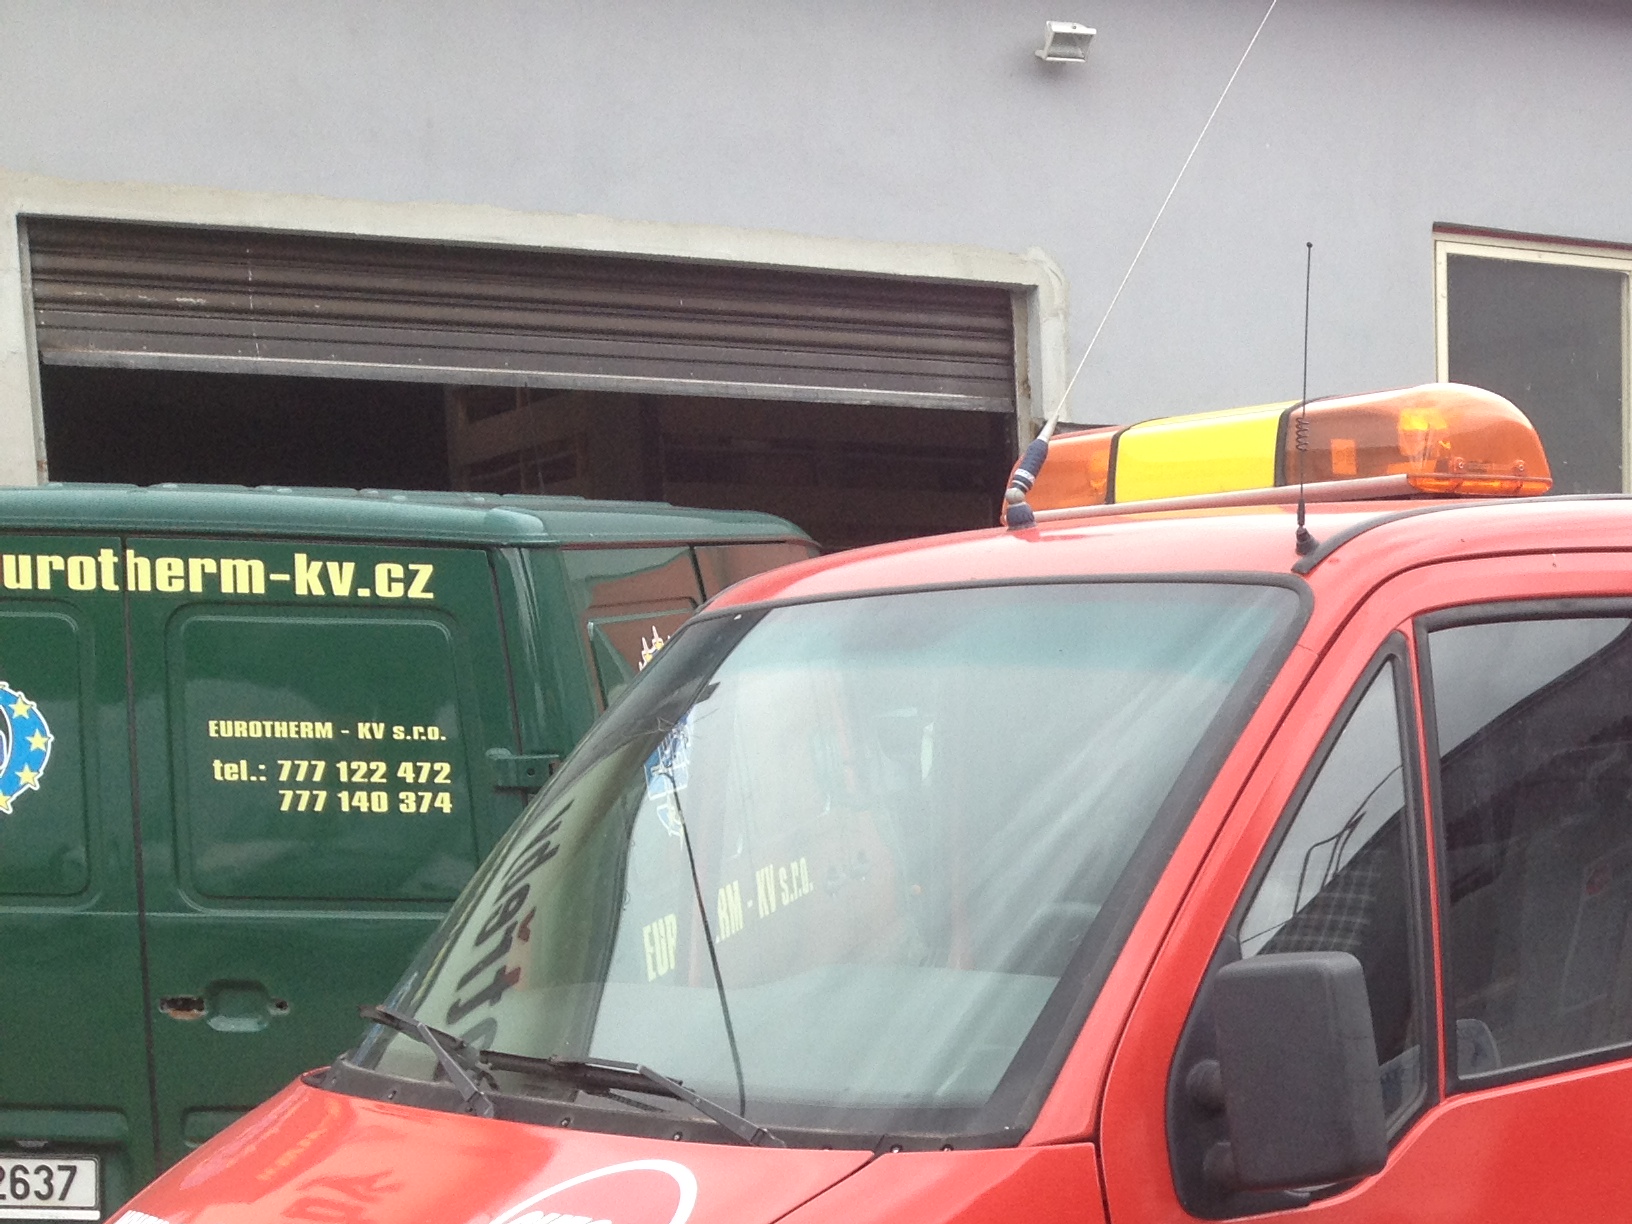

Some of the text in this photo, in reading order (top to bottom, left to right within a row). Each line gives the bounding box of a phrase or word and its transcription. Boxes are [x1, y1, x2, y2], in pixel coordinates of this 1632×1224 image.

[208, 720, 333, 739] EUROTHERM
[357, 722, 385, 740] KV
[392, 725, 447, 741] s.r.o.
[212, 759, 451, 784] tel.: 777 122 472
[278, 789, 452, 813] 777 140 374
